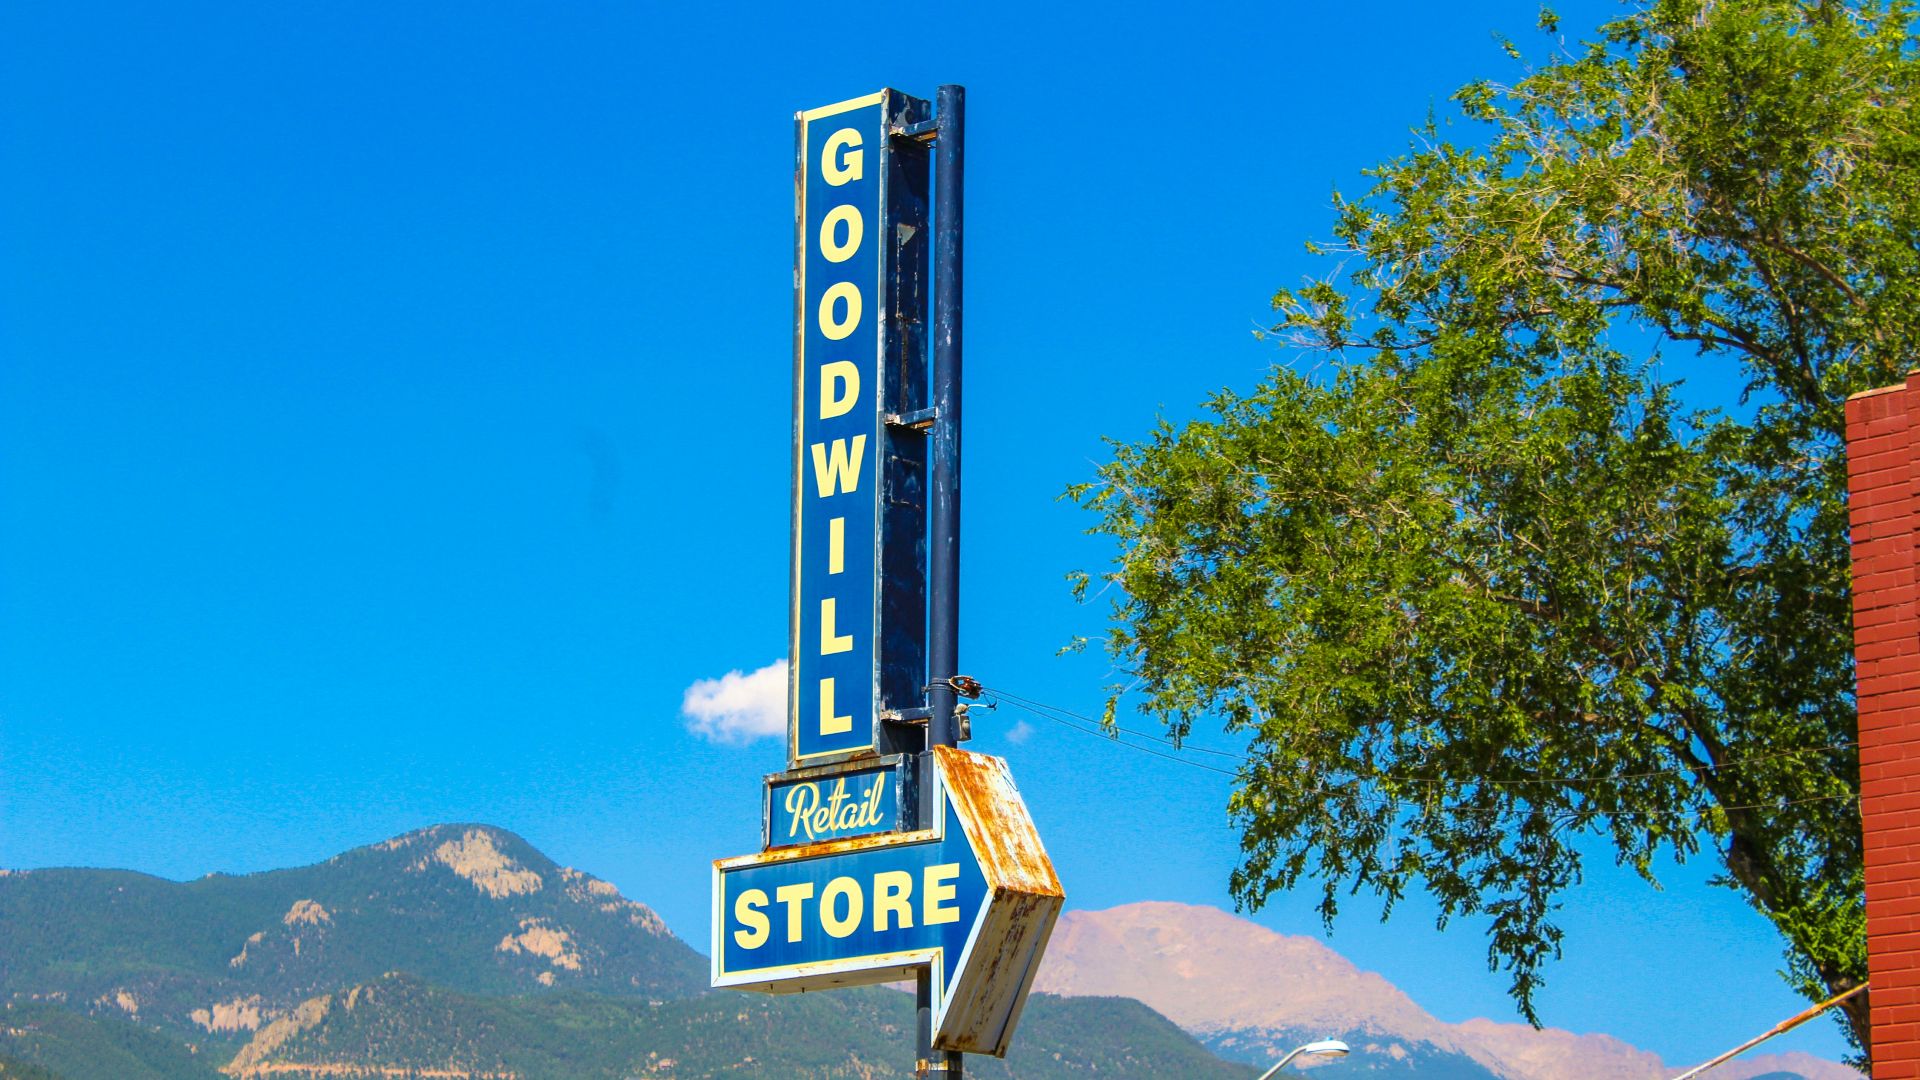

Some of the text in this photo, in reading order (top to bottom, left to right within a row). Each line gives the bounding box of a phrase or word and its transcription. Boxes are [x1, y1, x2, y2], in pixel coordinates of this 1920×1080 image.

[811, 127, 867, 736] GOODWILL
[785, 771, 885, 840] Retail
[734, 862, 960, 950] STORE
